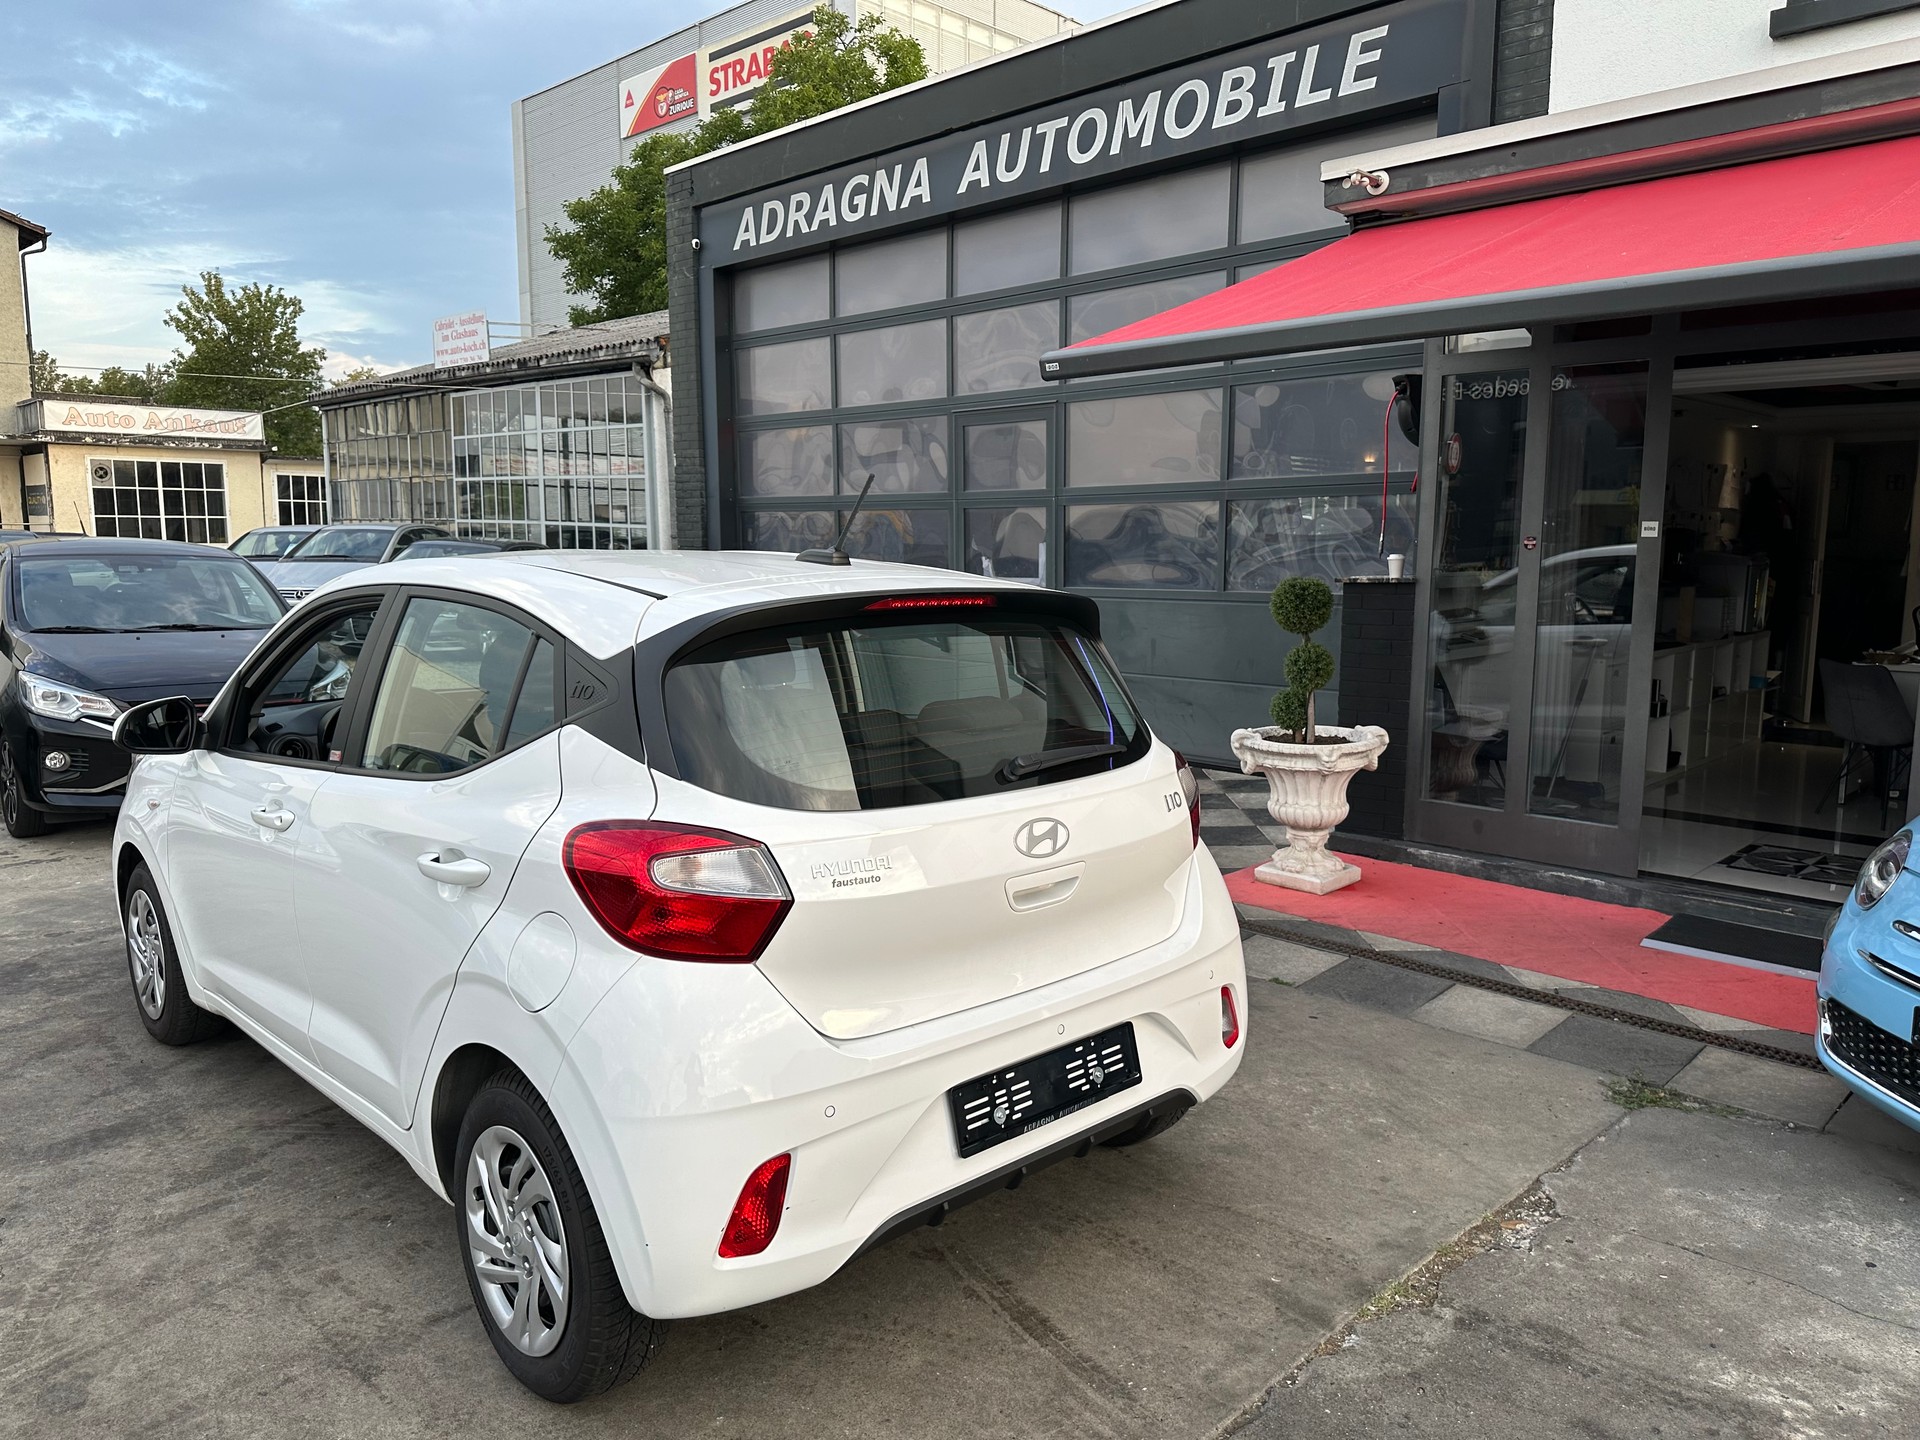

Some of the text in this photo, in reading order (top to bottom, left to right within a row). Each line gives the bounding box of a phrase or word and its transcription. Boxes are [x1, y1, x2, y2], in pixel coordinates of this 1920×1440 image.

[709, 31, 815, 97] STRAB
[669, 98, 694, 115] ZURIQUE
[732, 24, 1390, 251] ADRAGNA AUTOMOBILE
[62, 406, 247, 435] Auto Ankauf
[811, 856, 893, 879] HYUNDAI
[832, 875, 881, 888] faustauto
[1023, 1114, 1055, 1133] ADRAGNA
[543, 1145, 572, 1212] 175/65 R14
